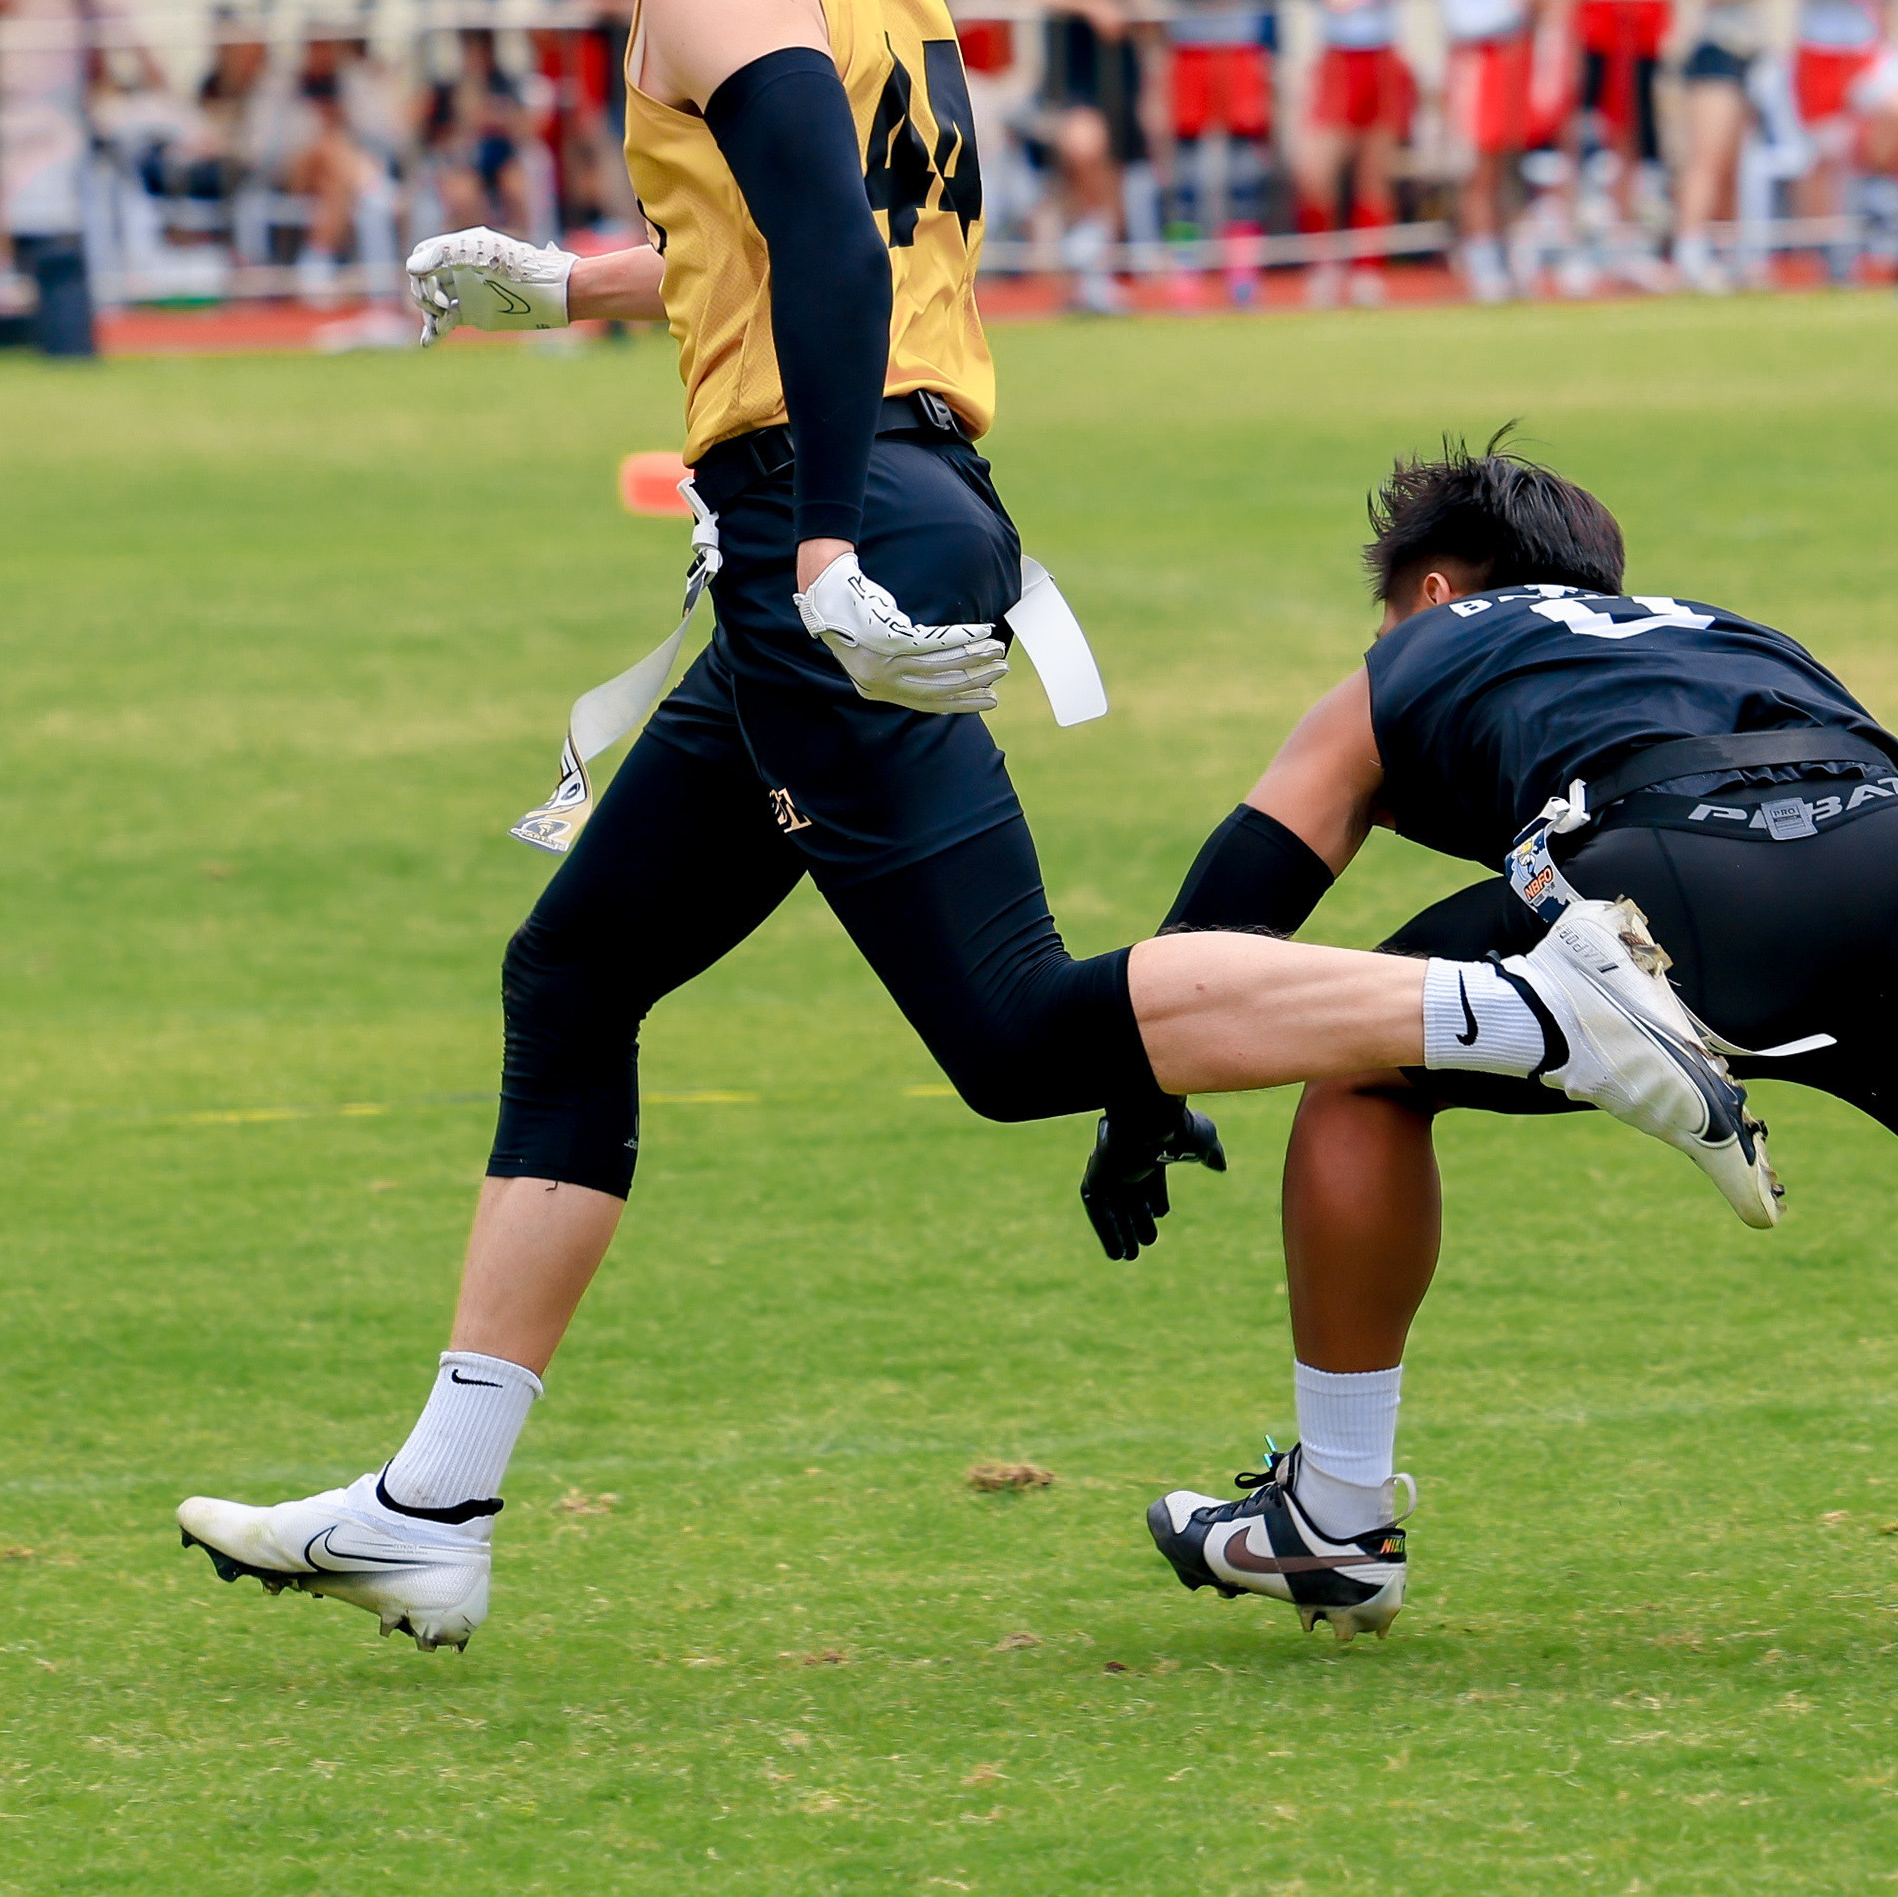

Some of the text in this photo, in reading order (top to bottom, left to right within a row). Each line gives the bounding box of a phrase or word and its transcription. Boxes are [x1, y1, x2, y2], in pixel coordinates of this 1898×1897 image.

[864, 30, 983, 252] 44
[1773, 807, 1796, 817] PRO
[1523, 865, 1554, 902] NBFO
